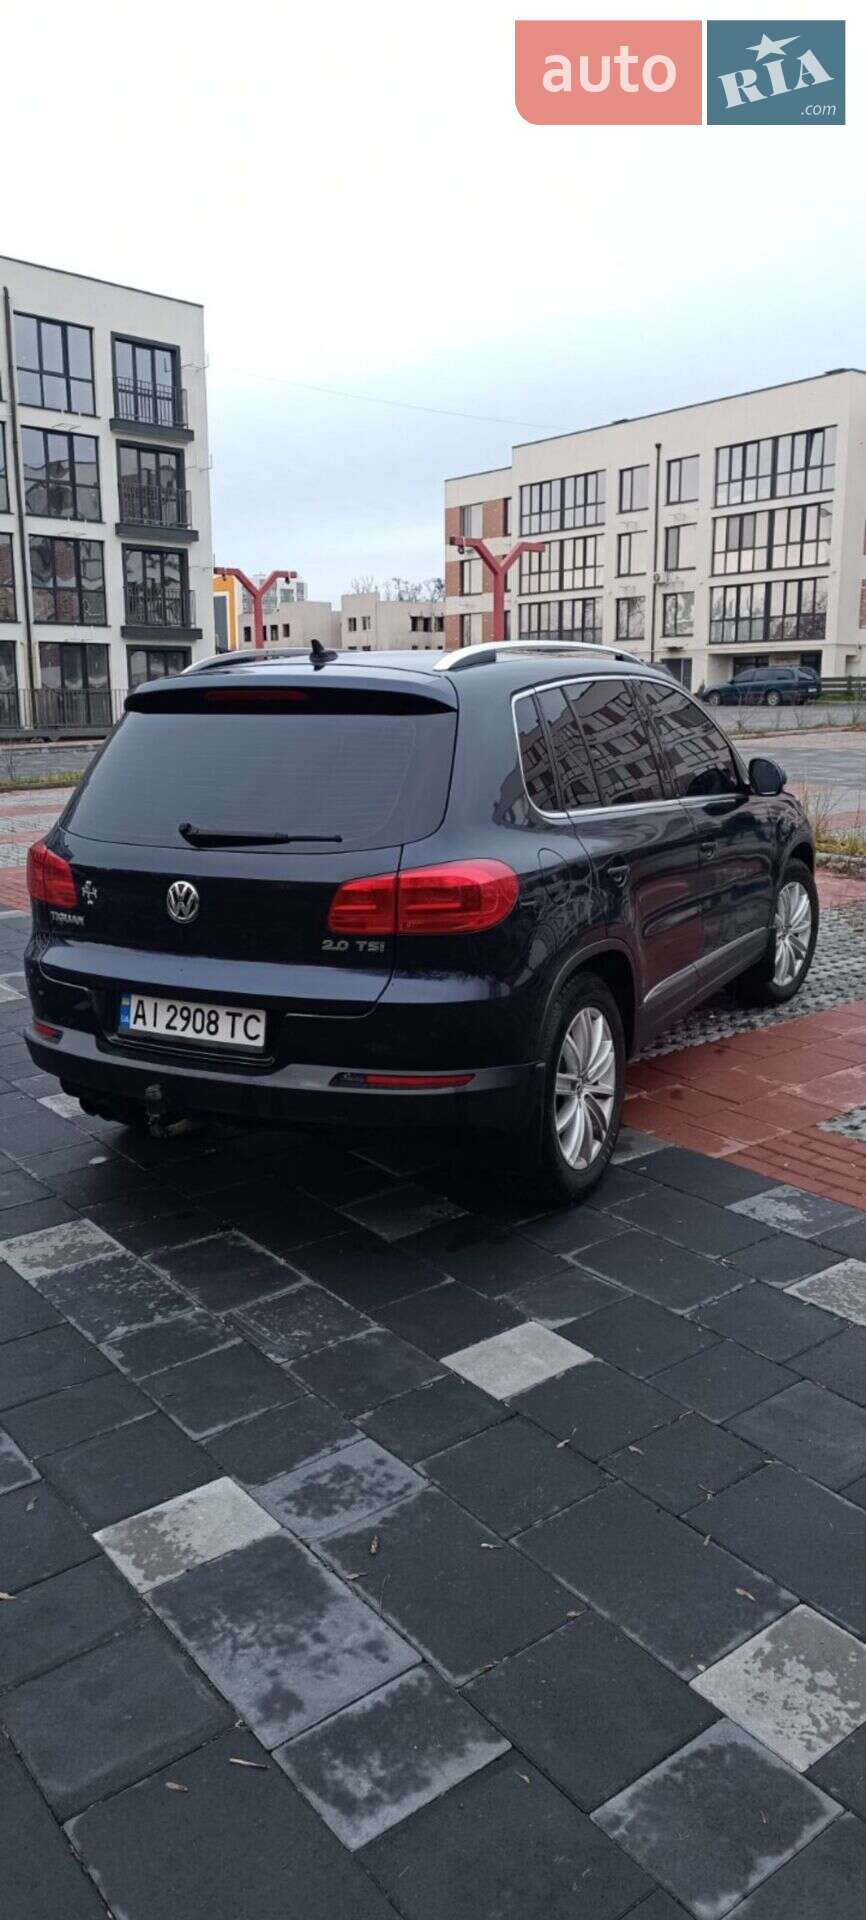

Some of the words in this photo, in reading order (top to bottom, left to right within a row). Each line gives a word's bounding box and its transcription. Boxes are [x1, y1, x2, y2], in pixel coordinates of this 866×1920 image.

[321, 939, 350, 951] 2.0
[355, 940, 385, 952] TSI
[133, 999, 158, 1028] AI
[165, 1004, 220, 1036] 2908
[225, 1011, 261, 1041] TC
